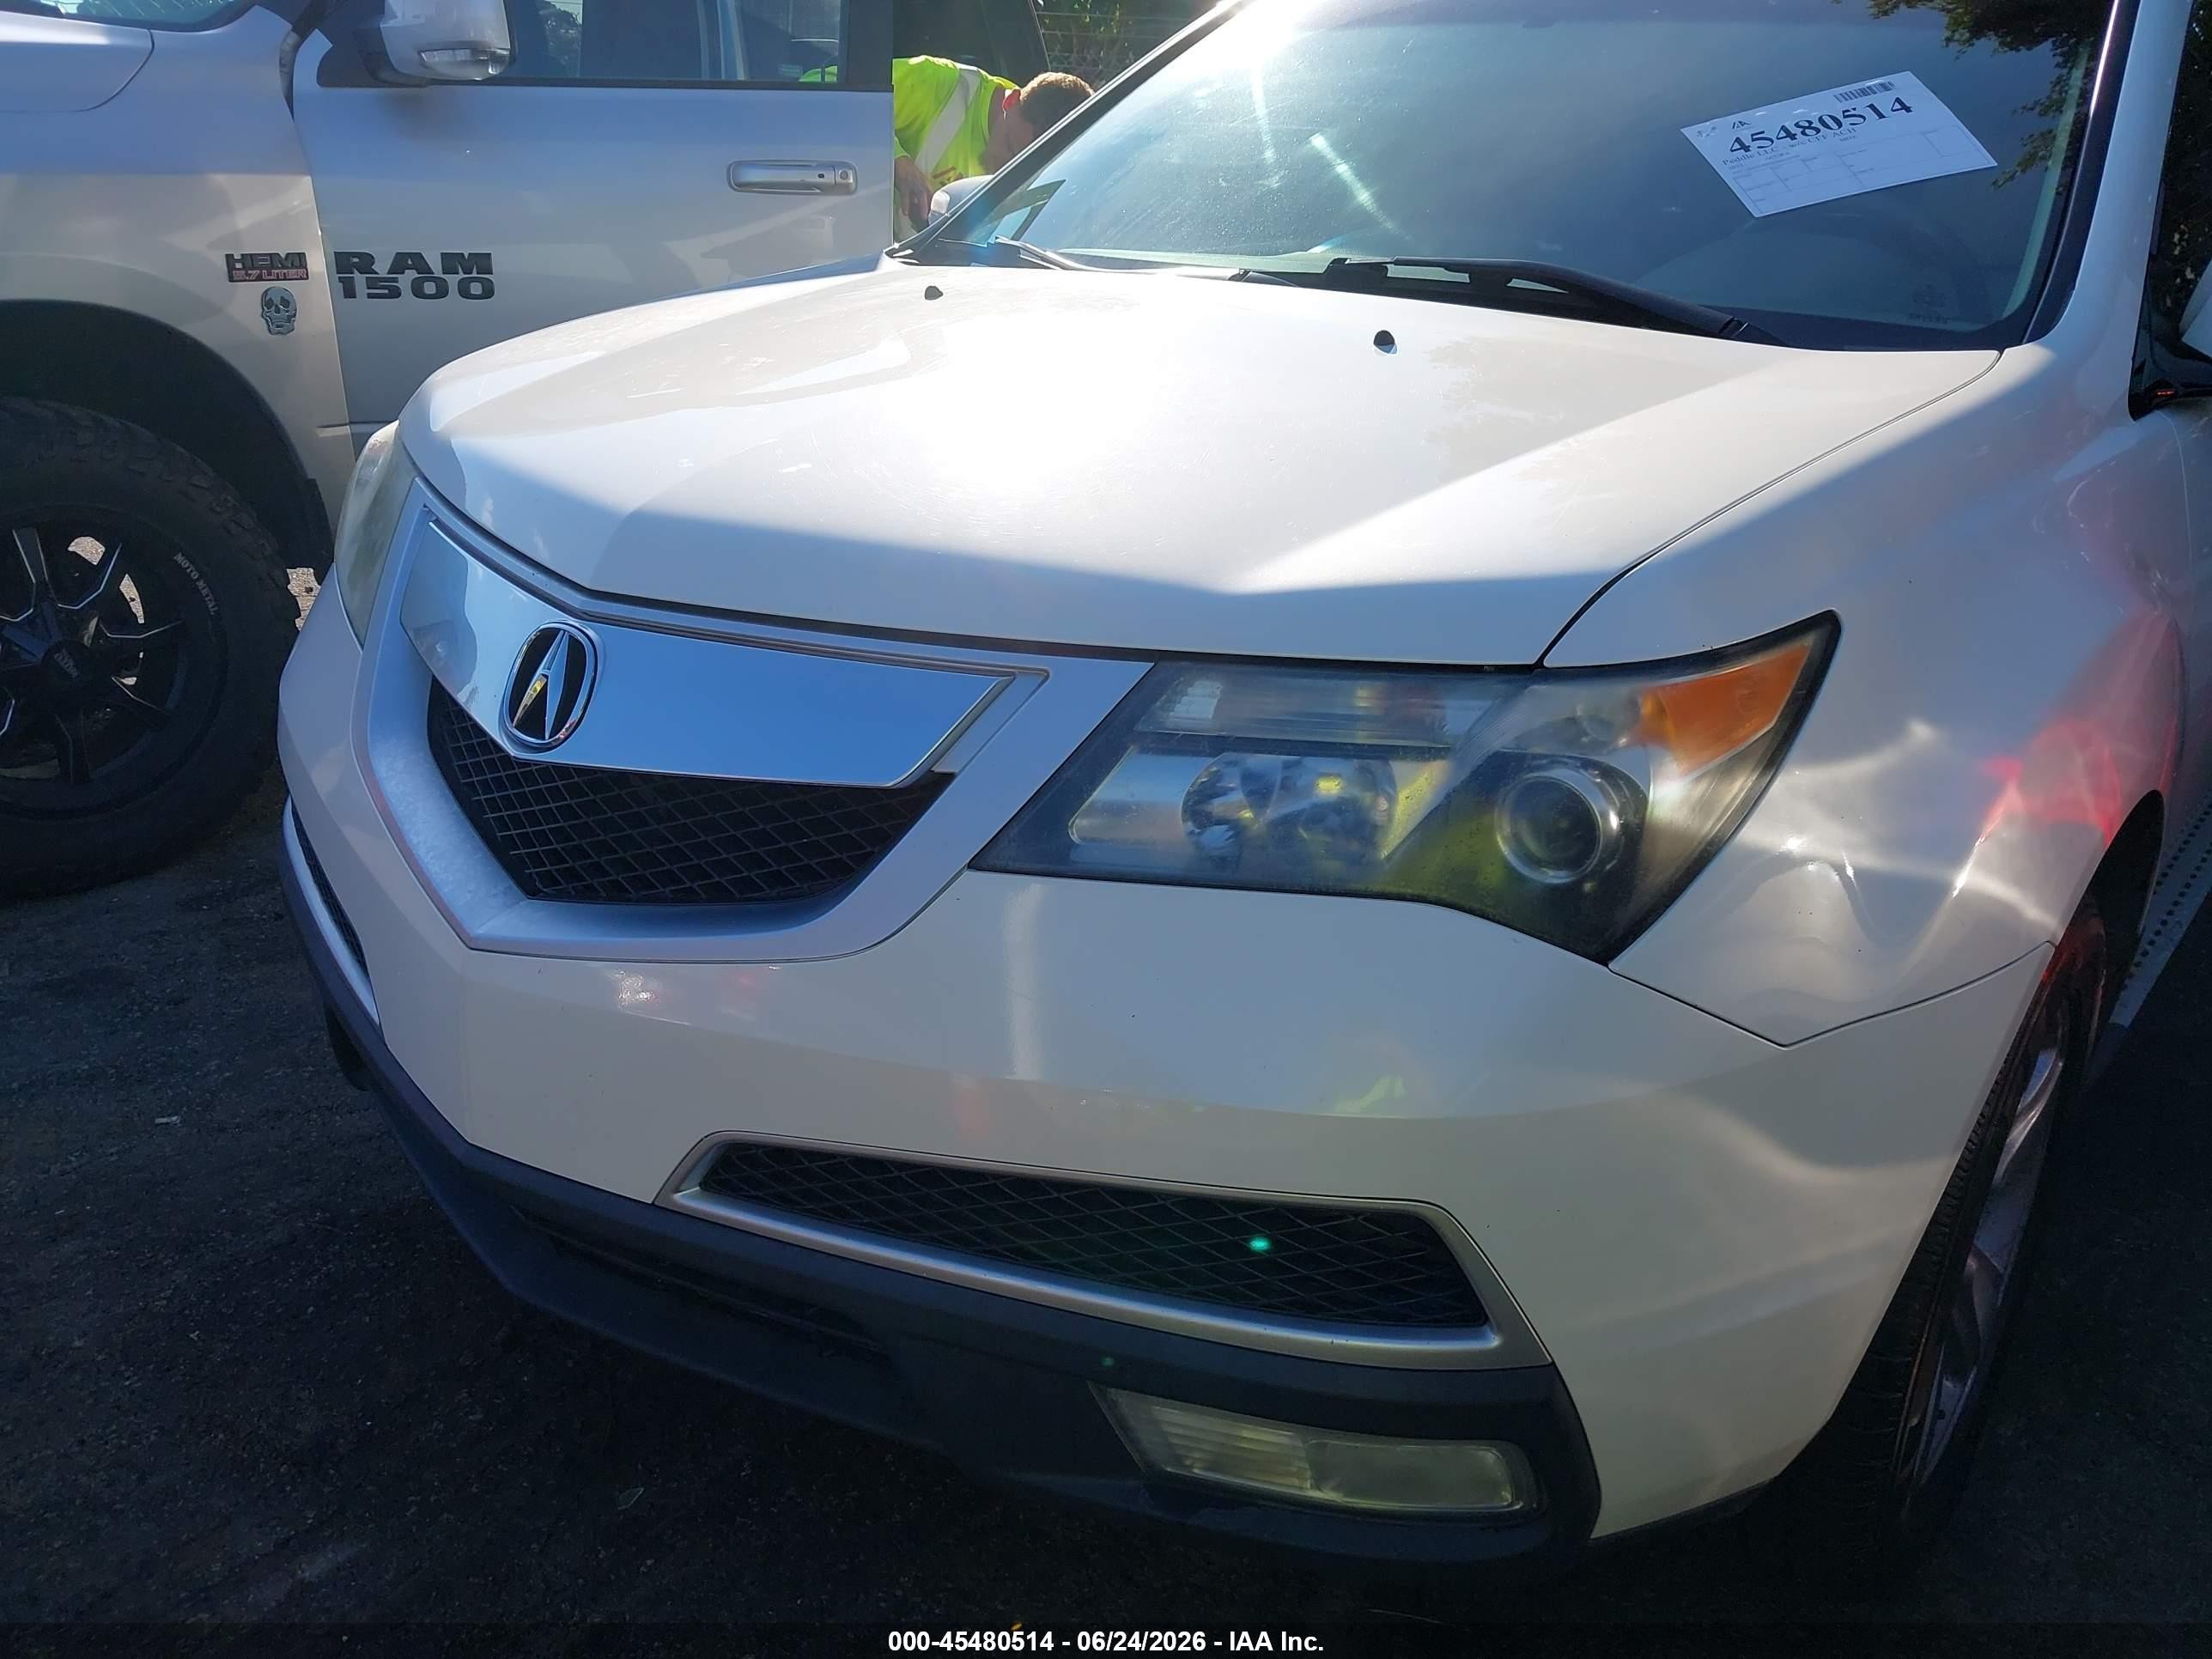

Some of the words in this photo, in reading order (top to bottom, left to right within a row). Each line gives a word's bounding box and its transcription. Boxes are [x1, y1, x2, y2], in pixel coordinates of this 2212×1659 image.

[1729, 96, 1913, 155] 45480514
[1722, 153, 1755, 166] Peddle
[225, 252, 307, 269] HEMI
[333, 251, 494, 276] RAM
[232, 269, 259, 281] 5.7
[261, 268, 307, 280] LITER
[338, 276, 495, 301] 1500
